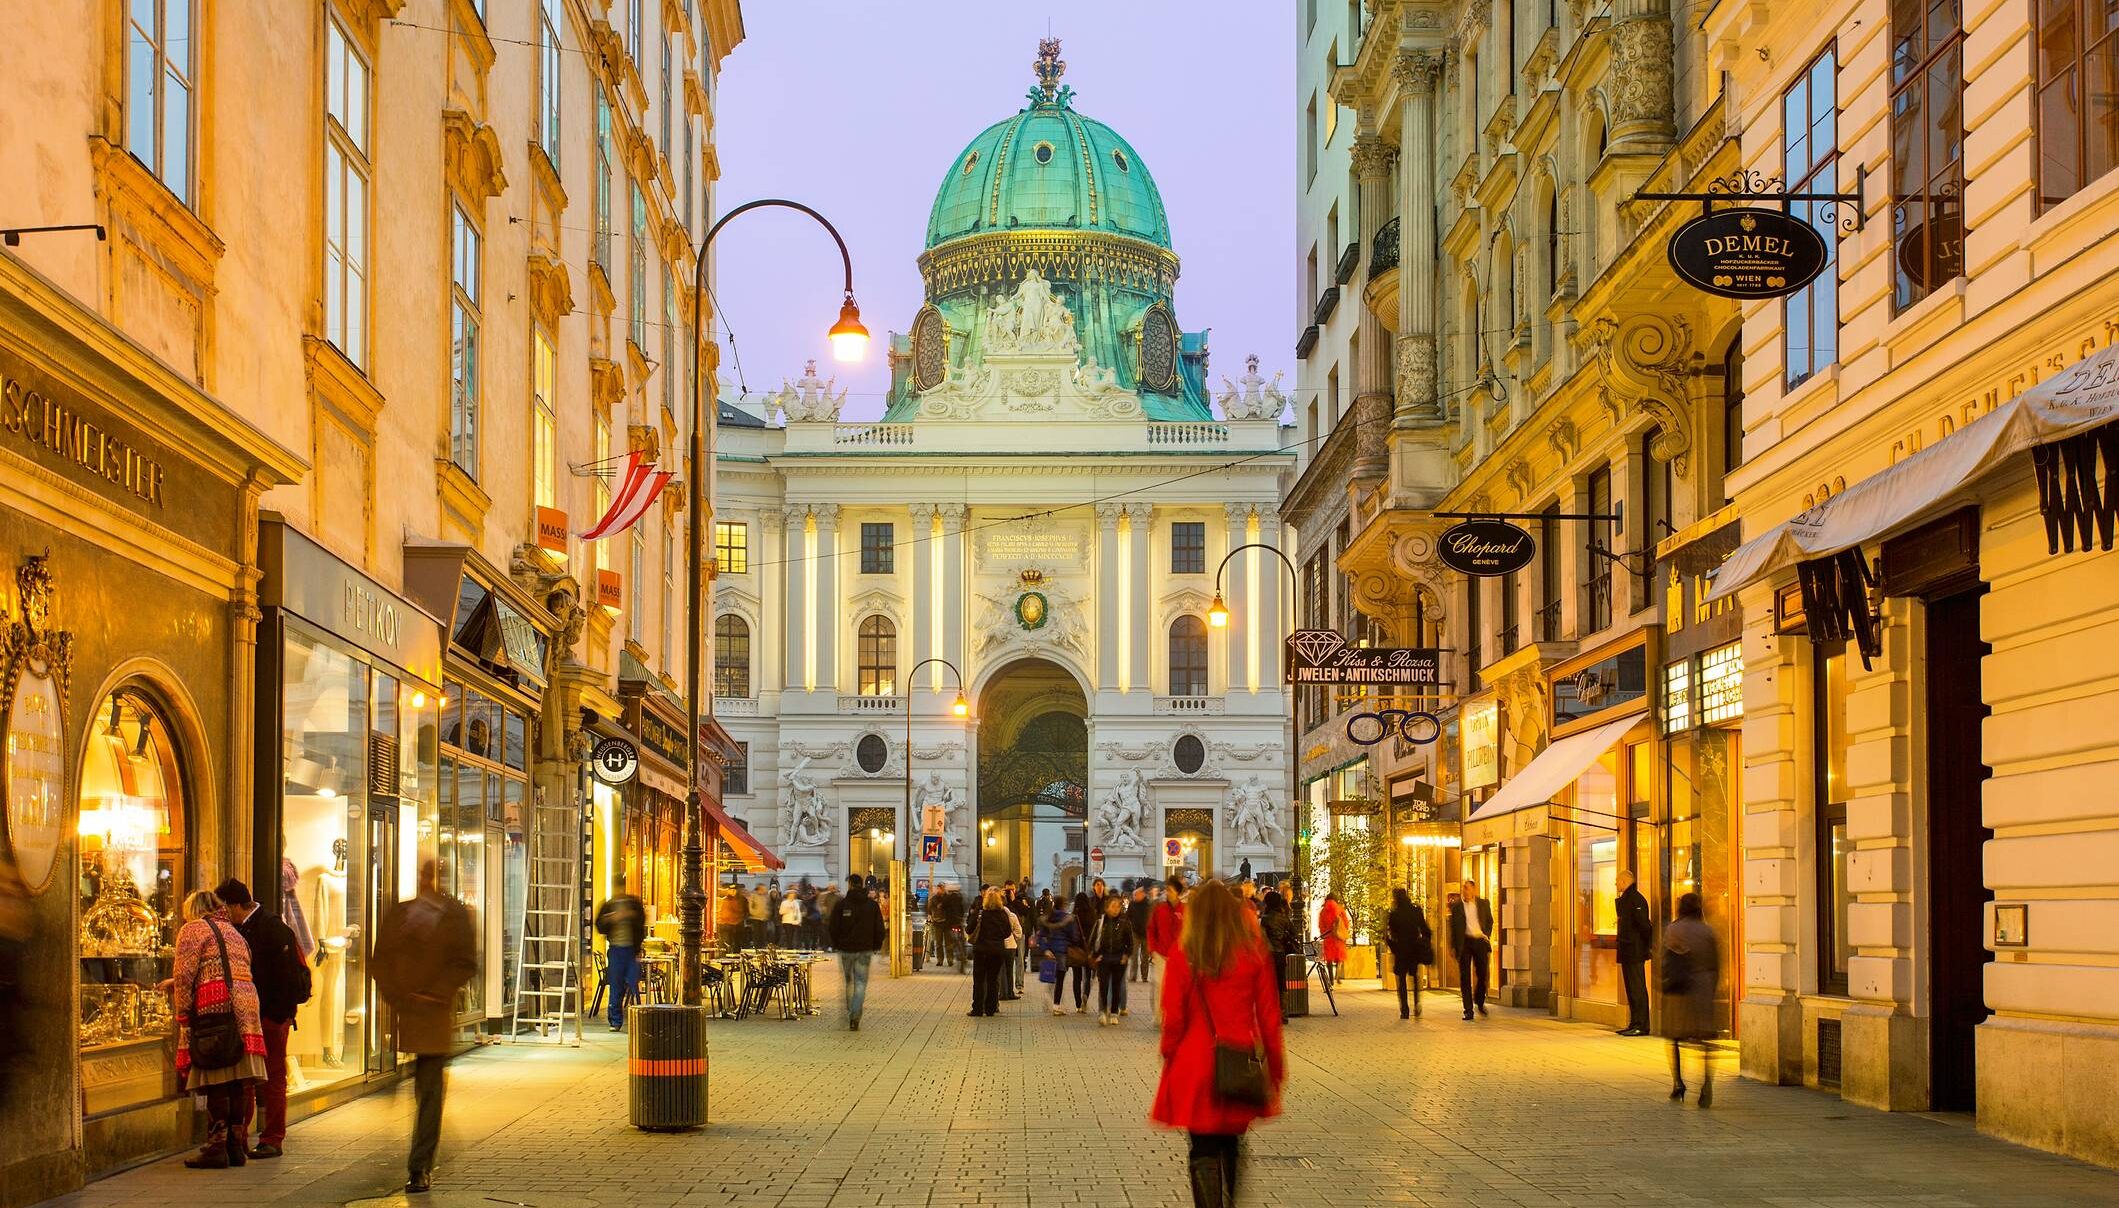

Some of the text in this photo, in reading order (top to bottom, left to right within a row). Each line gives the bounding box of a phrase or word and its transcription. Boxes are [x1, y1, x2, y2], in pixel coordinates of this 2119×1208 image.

[1704, 235, 1794, 257] DEMEL
[2056, 360, 2119, 395] DE
[1448, 532, 1524, 558] Chopard
[1472, 558, 1499, 566] GENÈVE
[345, 578, 402, 650] PETKOV
[1333, 649, 1435, 667] Kiss & Rozsa
[1346, 667, 1435, 682] ANTIKSCHMUCK
[595, 740, 635, 759] HEISSENBERGER
